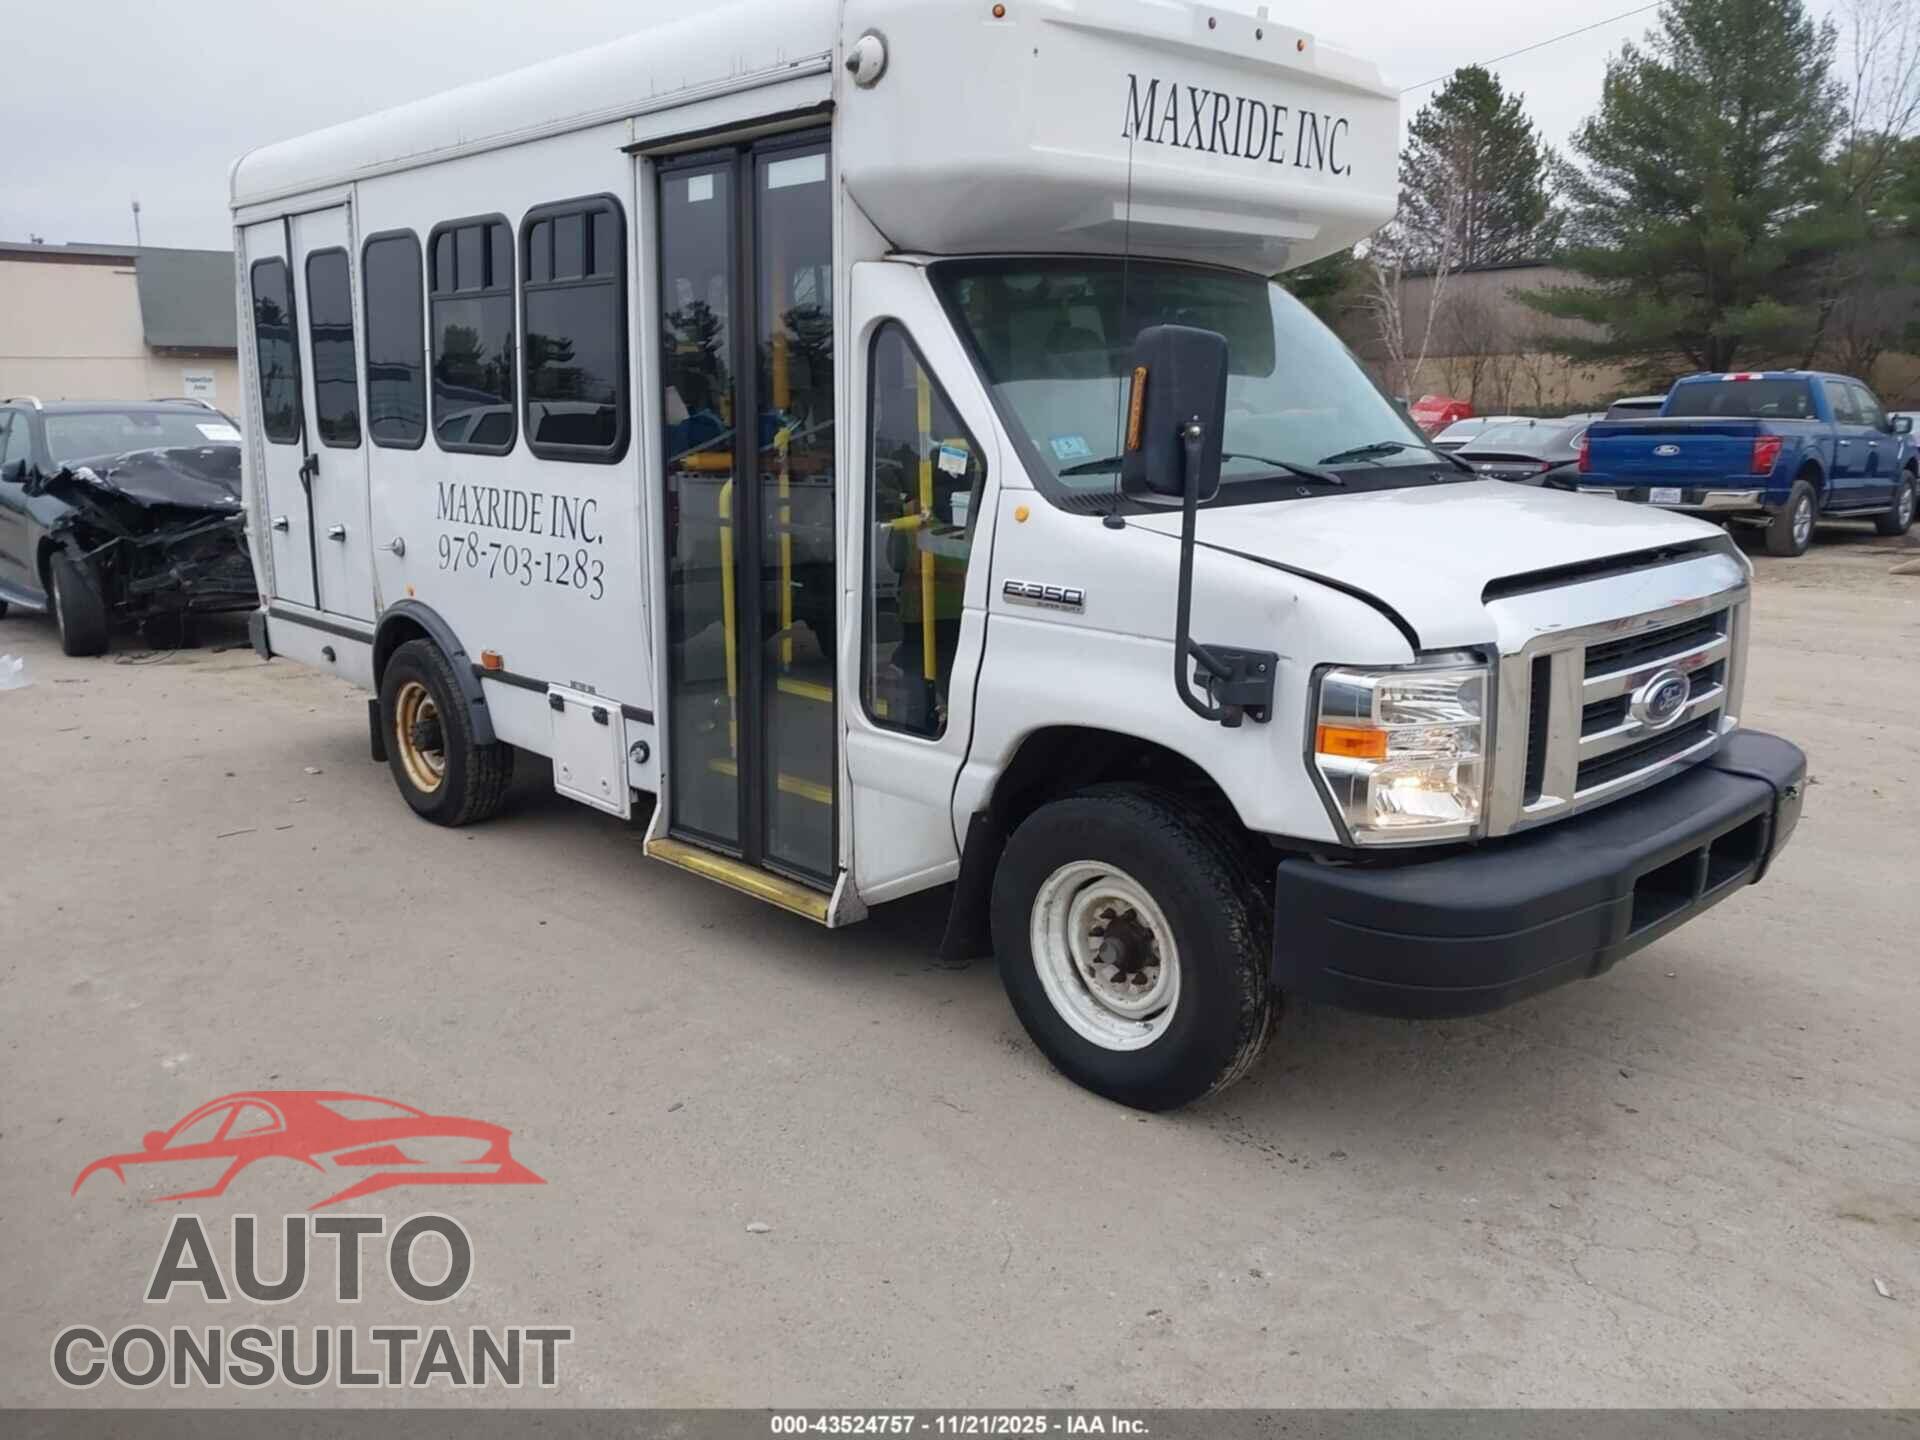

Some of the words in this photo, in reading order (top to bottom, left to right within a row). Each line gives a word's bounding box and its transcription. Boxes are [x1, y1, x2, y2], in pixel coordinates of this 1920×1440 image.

[1121, 73, 1289, 164] MAXRIDE
[1293, 109, 1352, 177] INC.
[436, 481, 544, 535] MAXRIDE
[549, 494, 603, 545] INC.
[438, 531, 605, 601] 978-703-1283
[1003, 580, 1083, 607] E-350
